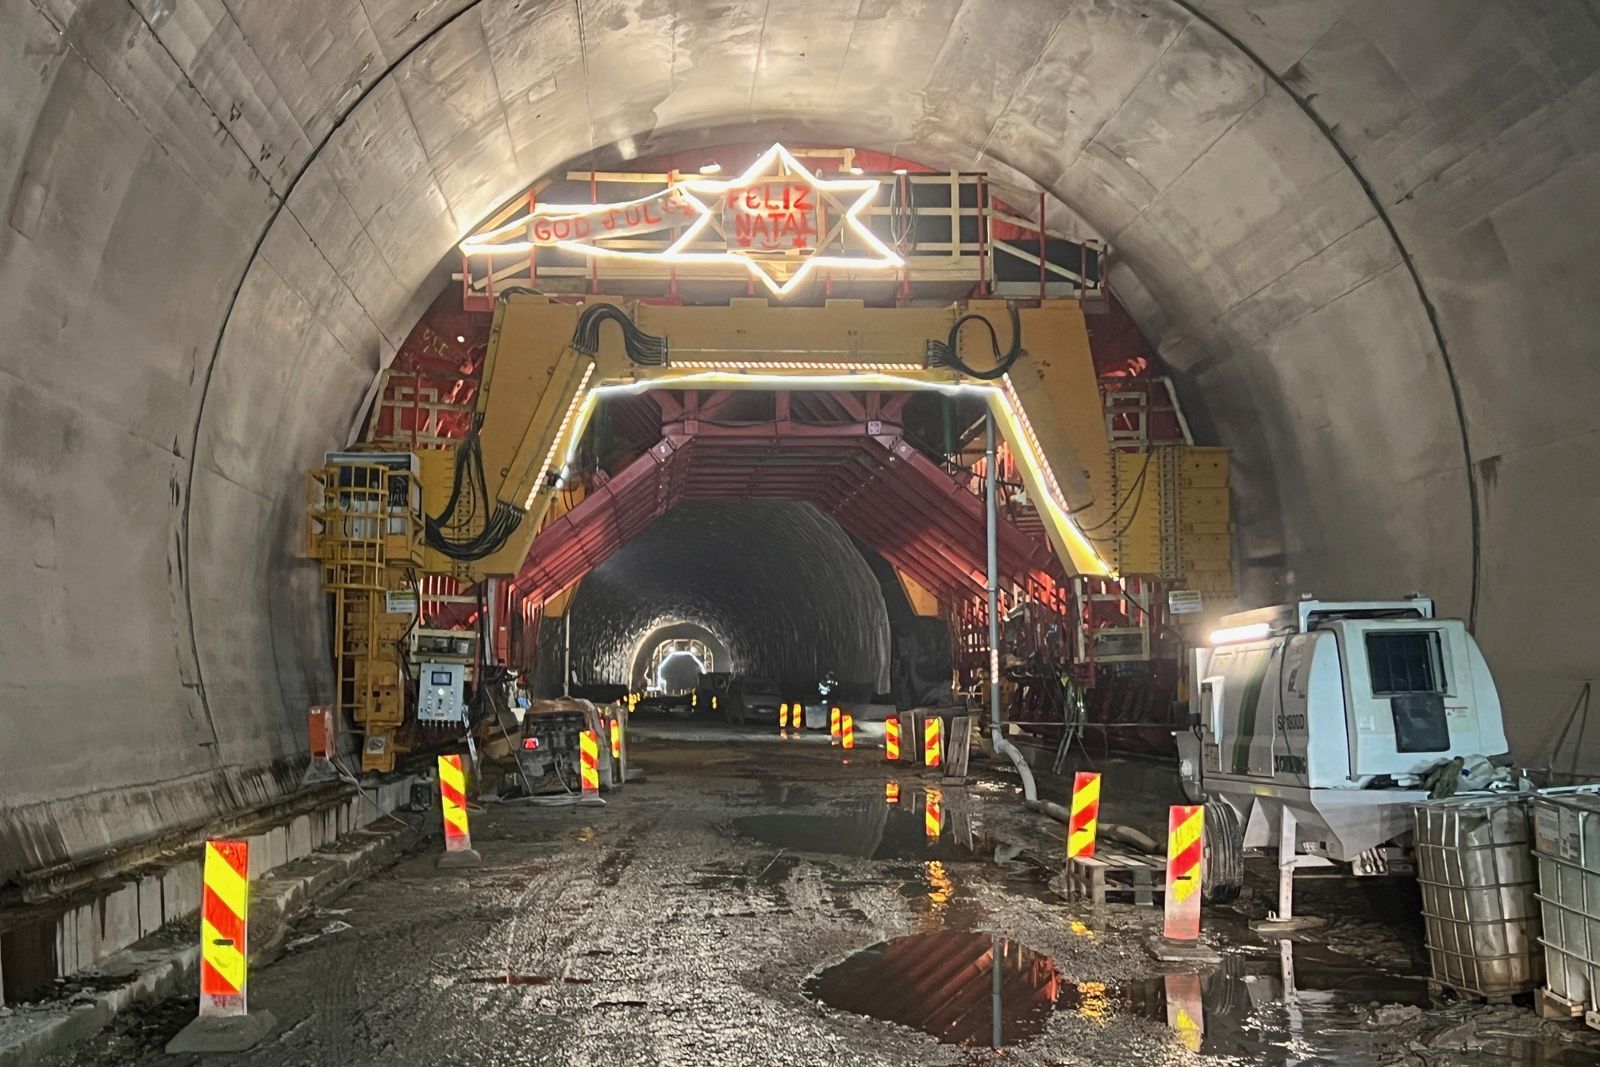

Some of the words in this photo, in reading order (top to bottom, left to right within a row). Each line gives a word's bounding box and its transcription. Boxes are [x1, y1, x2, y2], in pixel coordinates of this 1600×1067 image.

[726, 183, 814, 211] FELIZ
[534, 216, 591, 242] GOD
[601, 203, 663, 231] JUL
[734, 212, 817, 241] NATAL
